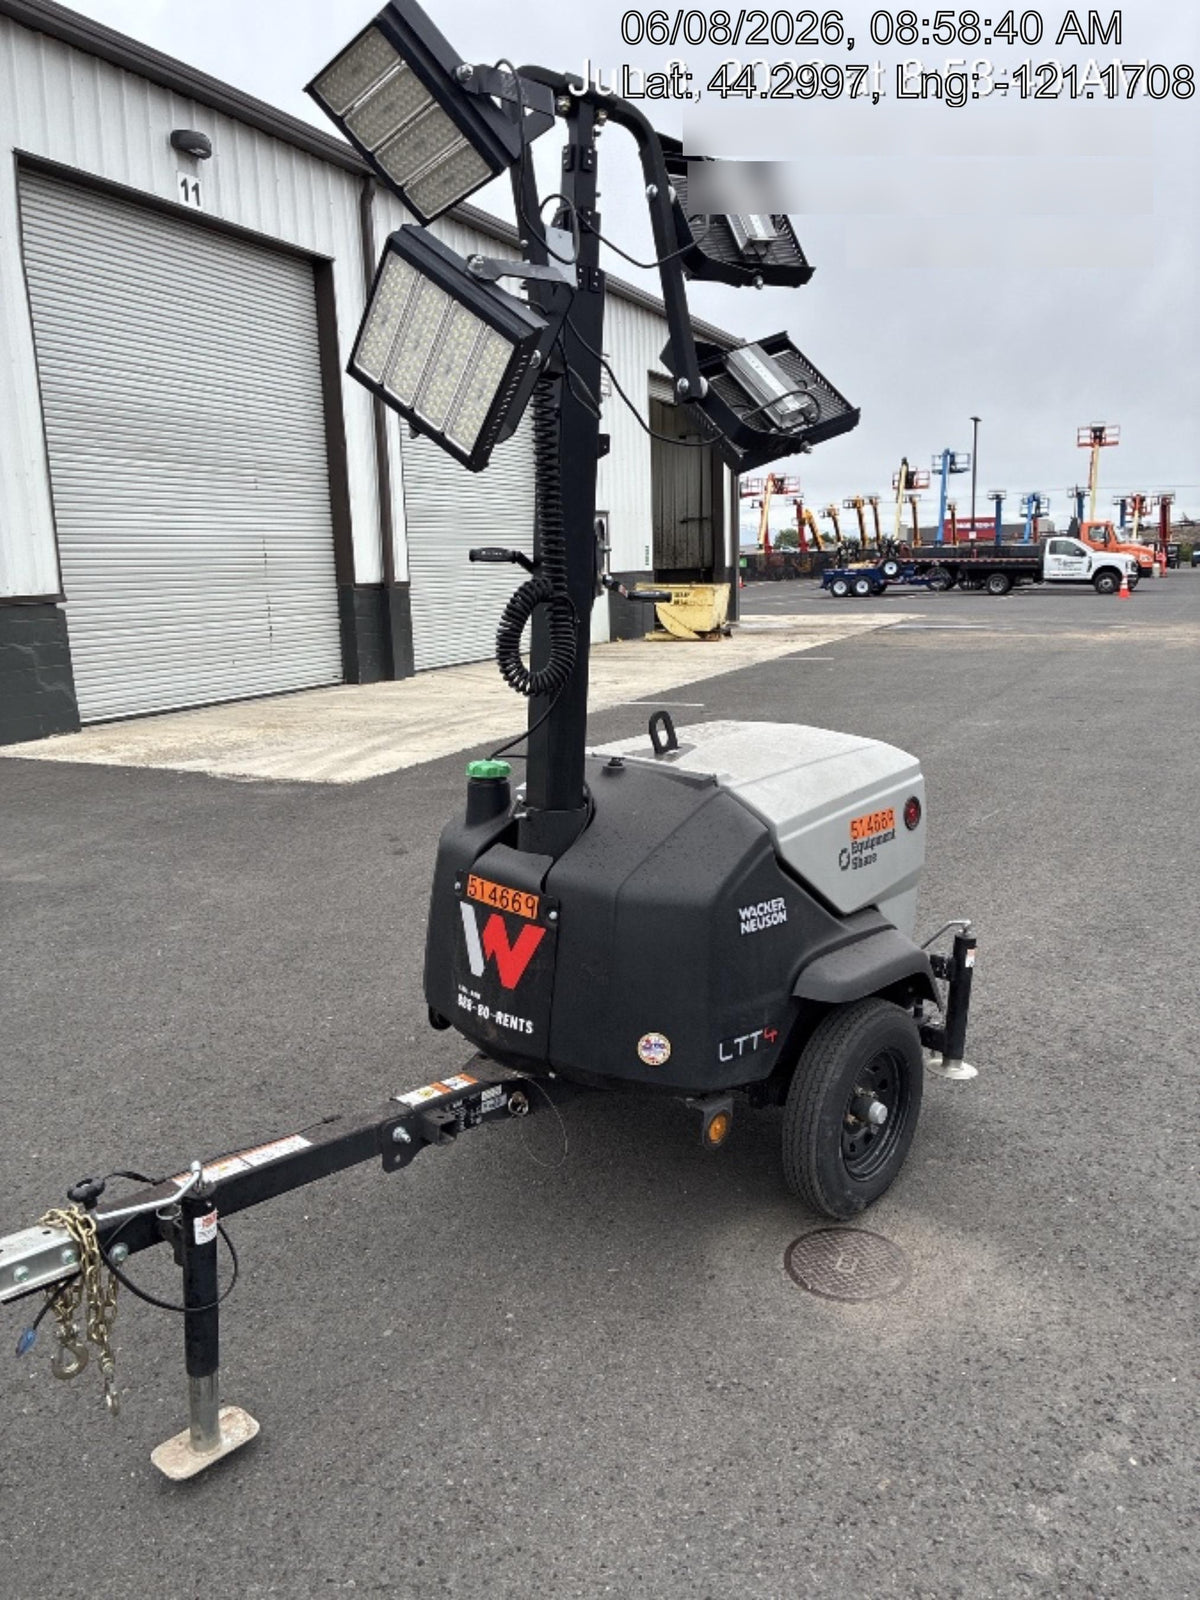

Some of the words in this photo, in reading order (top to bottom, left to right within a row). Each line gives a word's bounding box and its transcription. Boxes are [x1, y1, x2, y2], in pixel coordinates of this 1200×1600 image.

[180, 177, 201, 207] 11
[468, 876, 538, 919] 514669
[738, 897, 786, 921] WACKER
[740, 910, 788, 936] NEUSON
[718, 1026, 779, 1063] LTT4
